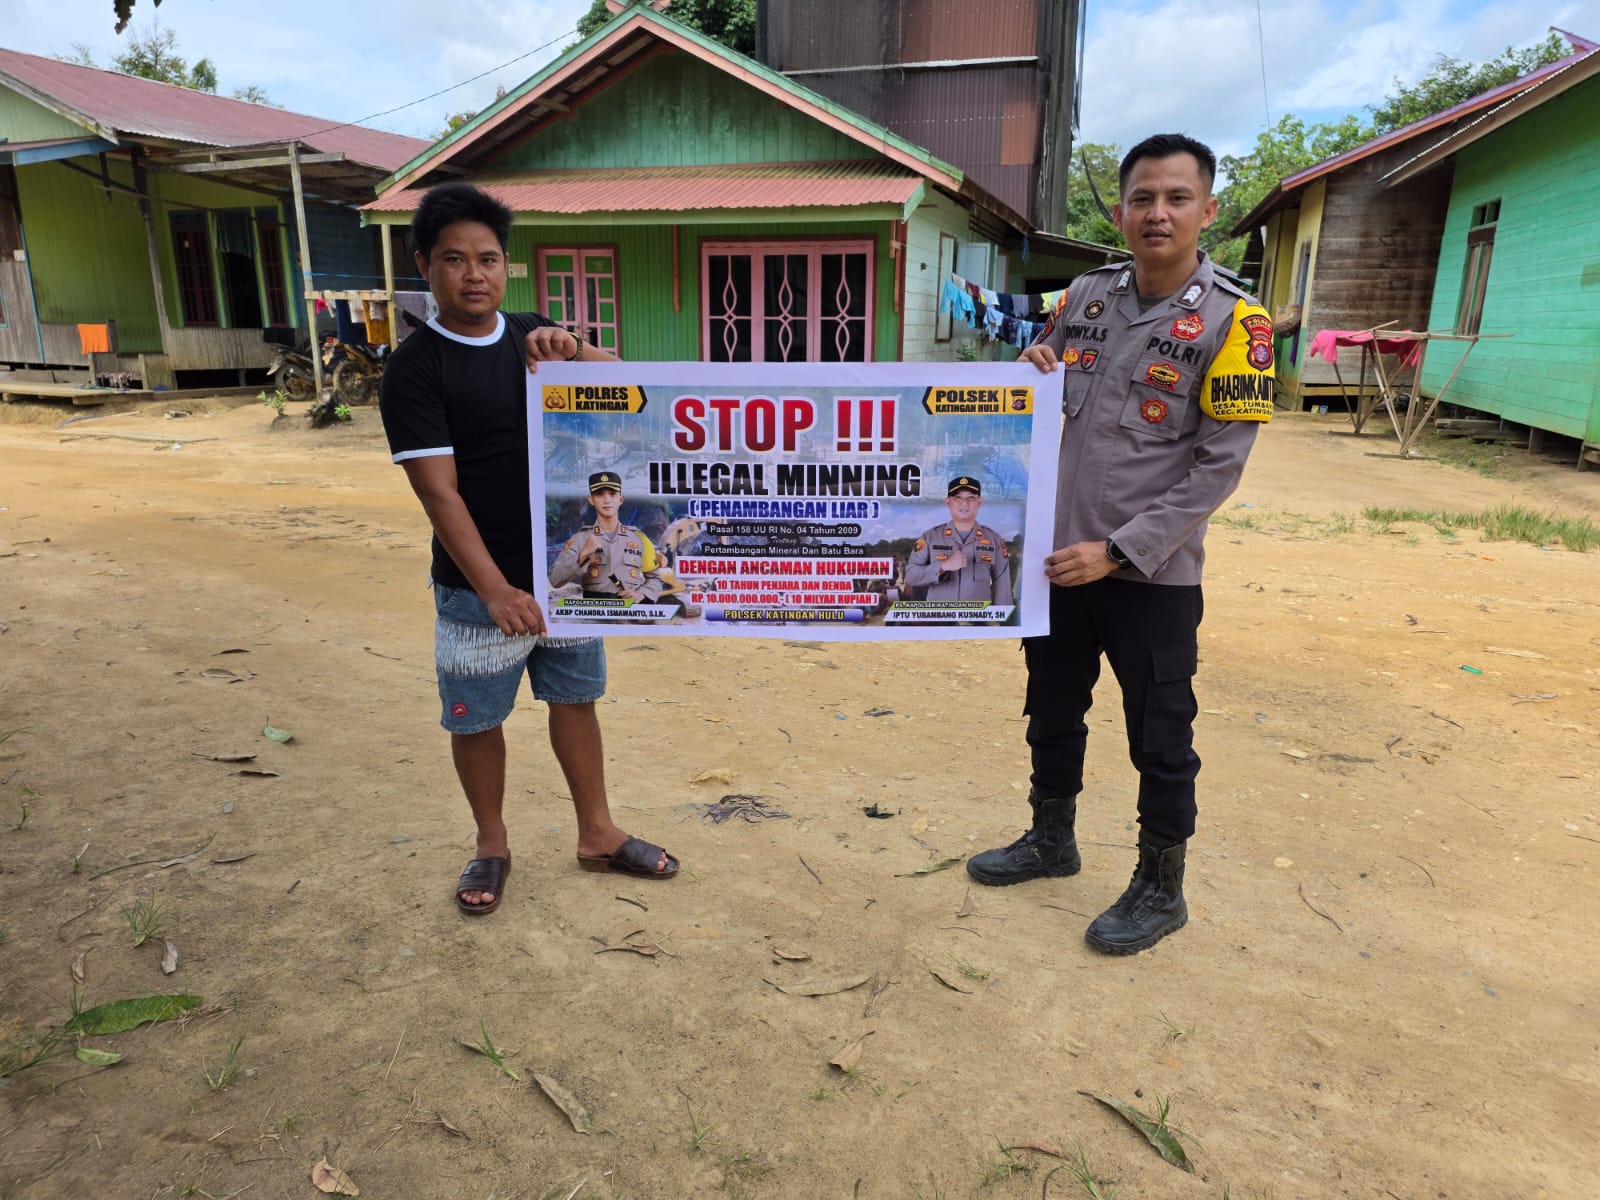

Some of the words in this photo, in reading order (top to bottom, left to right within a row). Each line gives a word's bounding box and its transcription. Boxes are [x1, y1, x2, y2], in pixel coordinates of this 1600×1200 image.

[1147, 336, 1202, 365] POLRI
[575, 387, 629, 400] POLRES
[935, 390, 999, 403] POLSEK
[575, 401, 629, 411] KATINGAN
[935, 404, 976, 413] KATINGAN
[978, 404, 999, 413] HULU
[674, 398, 814, 452] STOP
[837, 400, 896, 452] !!!
[650, 463, 769, 496] ILLEGAL
[777, 464, 921, 497] MINNING
[704, 546, 767, 555] Pertambangan
[844, 547, 864, 555] Bara
[679, 560, 737, 575] DENGAN
[740, 561, 813, 575] ANCAMAN
[816, 561, 890, 576] HUKUMAN
[717, 580, 728, 590] 10
[730, 581, 756, 590] TAHUN
[761, 581, 800, 590] PENJARA
[801, 581, 820, 590] DAN
[822, 581, 852, 590] DENDA
[607, 609, 648, 618] ISMAWANTO,
[724, 610, 763, 619] POLSEK
[765, 611, 815, 619] KATINGAN
[818, 611, 845, 620] HULU
